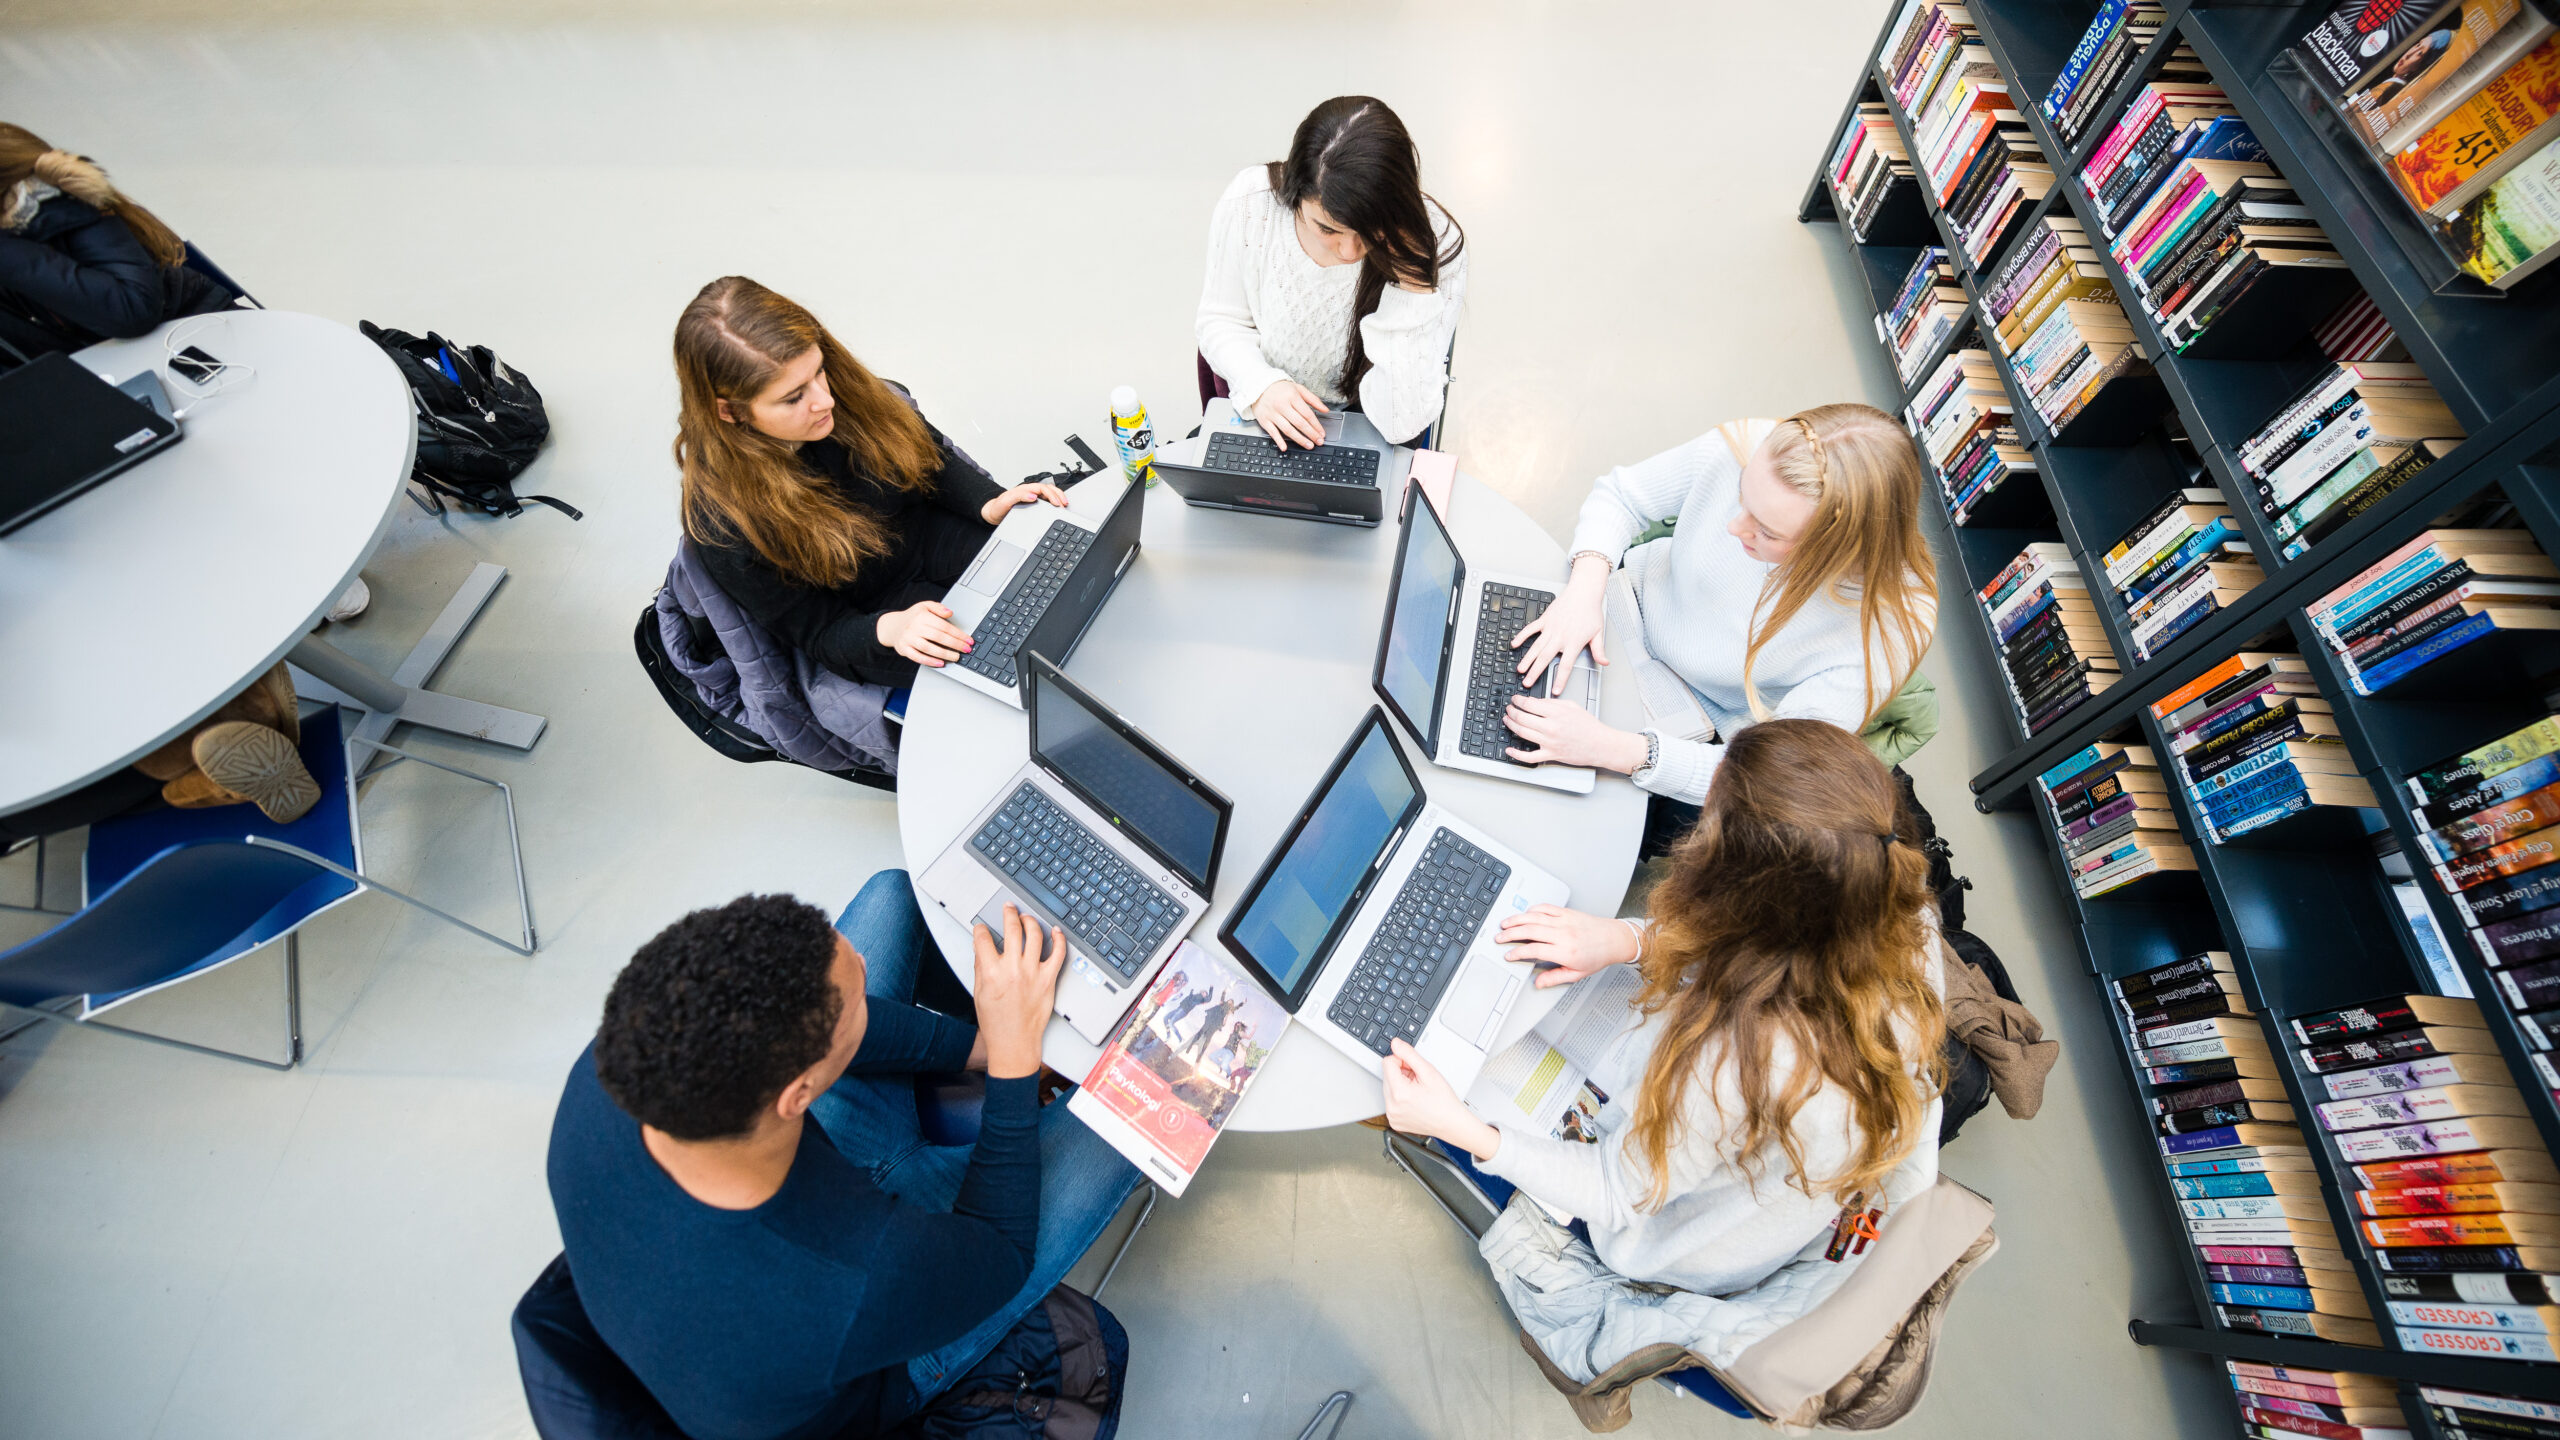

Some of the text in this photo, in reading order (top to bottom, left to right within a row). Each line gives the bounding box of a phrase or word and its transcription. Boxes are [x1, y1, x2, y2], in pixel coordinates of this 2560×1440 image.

[2328, 10, 2353, 38] malorie
[2066, 17, 2102, 65] ADAMS
[2066, 16, 2113, 79] DOUGLAS
[2309, 19, 2364, 83] blackman
[2507, 60, 2536, 92] RAY
[2353, 88, 2379, 114] PEARL
[2484, 74, 2538, 138] BRADBURY
[2362, 105, 2394, 139] EARRING
[2478, 106, 2517, 150] Fahrenheit
[2094, 98, 2163, 187] CRIMES SOUTHERN INDIANA FRANK BILL
[2454, 126, 2499, 170] 451
[2169, 206, 2178, 216] THE
[1998, 226, 2045, 282] DAN BROWN
[2143, 235, 2212, 305] IN THE AFTERLIGHT
[2013, 256, 2061, 315] DAN BROWN
[2175, 281, 2191, 298] ANDY
[2020, 272, 2071, 330] DAN BROWN
[2161, 296, 2177, 314] BRIGGS
[2026, 317, 2057, 352] DAN BROWN
[2033, 332, 2064, 365] DAN BROWN
[2042, 344, 2073, 378] DAN BROWN
[2112, 347, 2134, 370] DAN
[2051, 351, 2084, 386] DAN BROWN
[2059, 369, 2092, 405] DAN BROWN
[2330, 393, 2354, 414] iBoy
[2310, 422, 2352, 456] TERRY BROOKS
[2260, 440, 2298, 472] KEVIN BROOKS
[2316, 441, 2357, 474] TERRY BROOKS
[2386, 447, 2416, 471] JERLE
[2339, 467, 2391, 507] SHANNARA
[2344, 454, 2430, 520] TERRY BROOKS
[2132, 495, 2187, 539] GOLDEN SON
[2157, 531, 2187, 555] Bukowski
[2181, 524, 2217, 553] BURSTYN
[2146, 567, 2162, 582] INC.
[2157, 551, 2183, 573] WATER
[2435, 561, 2467, 587] TRACY
[2197, 583, 2207, 593] S.
[2205, 577, 2215, 587] A.
[2347, 562, 2383, 590] boy proof
[2146, 599, 2164, 615] LUNCH
[2159, 587, 2180, 605] NAKED
[2174, 589, 2200, 610] BYATT
[2387, 578, 2439, 616] CHEVALIER
[2177, 610, 2197, 627] BYATT
[2360, 619, 2372, 630] and
[2368, 611, 2383, 625] Lady
[2380, 607, 2391, 619] the
[2396, 591, 2458, 633] TRACY CHEVALIER
[2436, 606, 2463, 627] TRACY
[2150, 626, 2169, 642] BOOK
[2398, 617, 2439, 647] CHEVALIER
[2415, 635, 2447, 661] WOODS
[2237, 715, 2265, 734] Colfer
[2262, 705, 2286, 722] Eoin
[2203, 727, 2241, 752] Plugged
[2258, 728, 2296, 749] AND ANOTHER
[2198, 753, 2231, 773] EOIN COLFER
[2225, 745, 2286, 782] ARTEMIS
[2441, 744, 2515, 787] City of Bones
[2065, 783, 2076, 791] GODS
[2088, 776, 2116, 797] CONNELLY
[2094, 786, 2117, 802] MICHAEL
[2236, 764, 2294, 798] ARTEMIS
[2447, 773, 2523, 815] City of Ashes
[2079, 798, 2088, 807] The
[2241, 777, 2301, 812] ARTEMIS
[2281, 794, 2304, 808] COLFER
[2287, 800, 2303, 811] EOIN
[2459, 801, 2535, 846] City of Glass
[2450, 835, 2553, 882] City of Fallen Angels
[2468, 881, 2542, 918] of Lost Souls
[2499, 919, 2552, 956] Princess
[2149, 959, 2201, 985] Bernard Cornwell
[2155, 981, 2207, 1006] Bernard Cornwell
[2338, 1007, 2366, 1022] GAMES
[2347, 1014, 2378, 1030] HUNGER
[2148, 1021, 2204, 1046] Bernard Cornwell
[2170, 1039, 2223, 1062] Bernard Cornwell
[2343, 1040, 2369, 1054] GAMES
[2351, 1046, 2378, 1060] HUNGER
[1103, 1064, 1165, 1115] Psykologi
[1166, 1112, 1177, 1124] 1
[2221, 1248, 2254, 1262] Named
[2240, 1314, 2253, 1323] LOST
[2414, 1307, 2494, 1325] CROSSED
[2421, 1332, 2503, 1352] CROSSED
